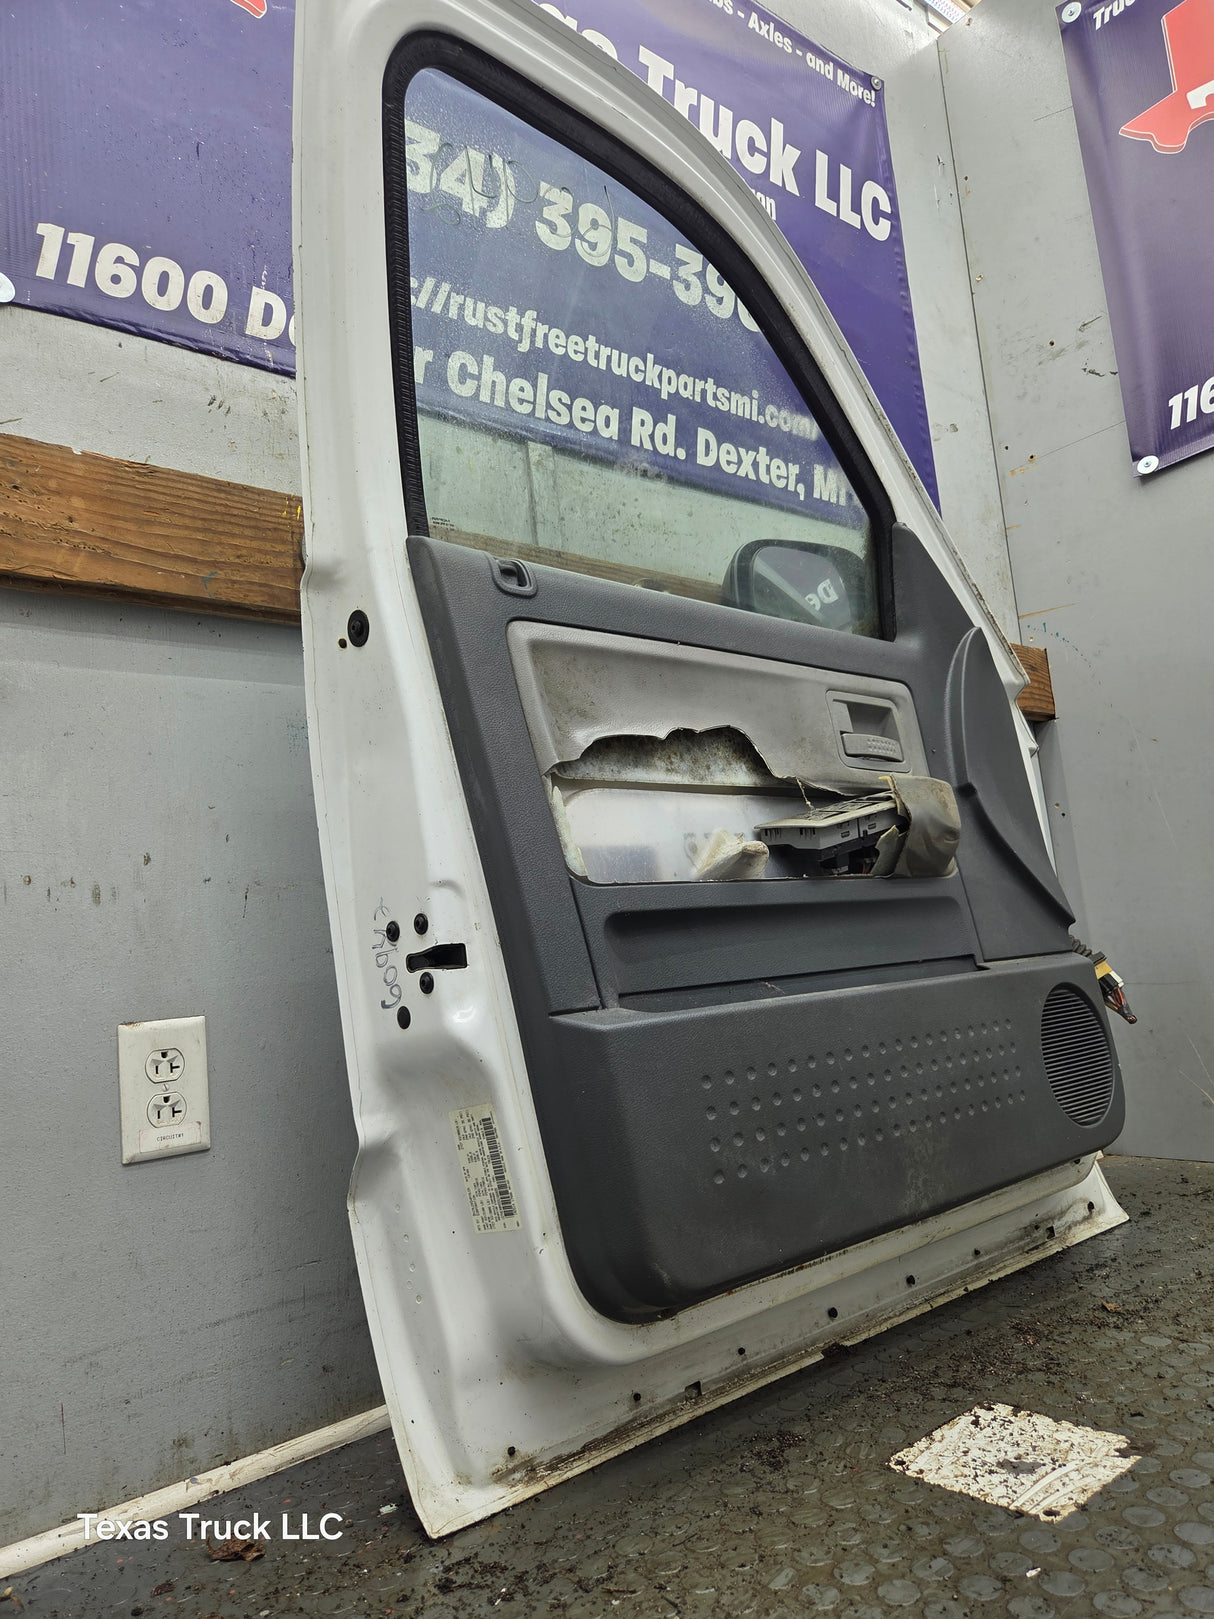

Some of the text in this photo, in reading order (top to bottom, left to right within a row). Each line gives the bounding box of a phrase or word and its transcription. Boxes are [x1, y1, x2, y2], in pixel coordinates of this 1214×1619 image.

[638, 44, 892, 242] Truck LLC
[747, 11, 793, 54] Axles
[806, 52, 834, 81] and
[836, 68, 876, 108] More!
[36, 223, 229, 324] 11600
[245, 286, 296, 347] D
[447, 350, 620, 440] Chelsea
[630, 406, 686, 460] Rd.
[696, 427, 805, 501] Dexter,
